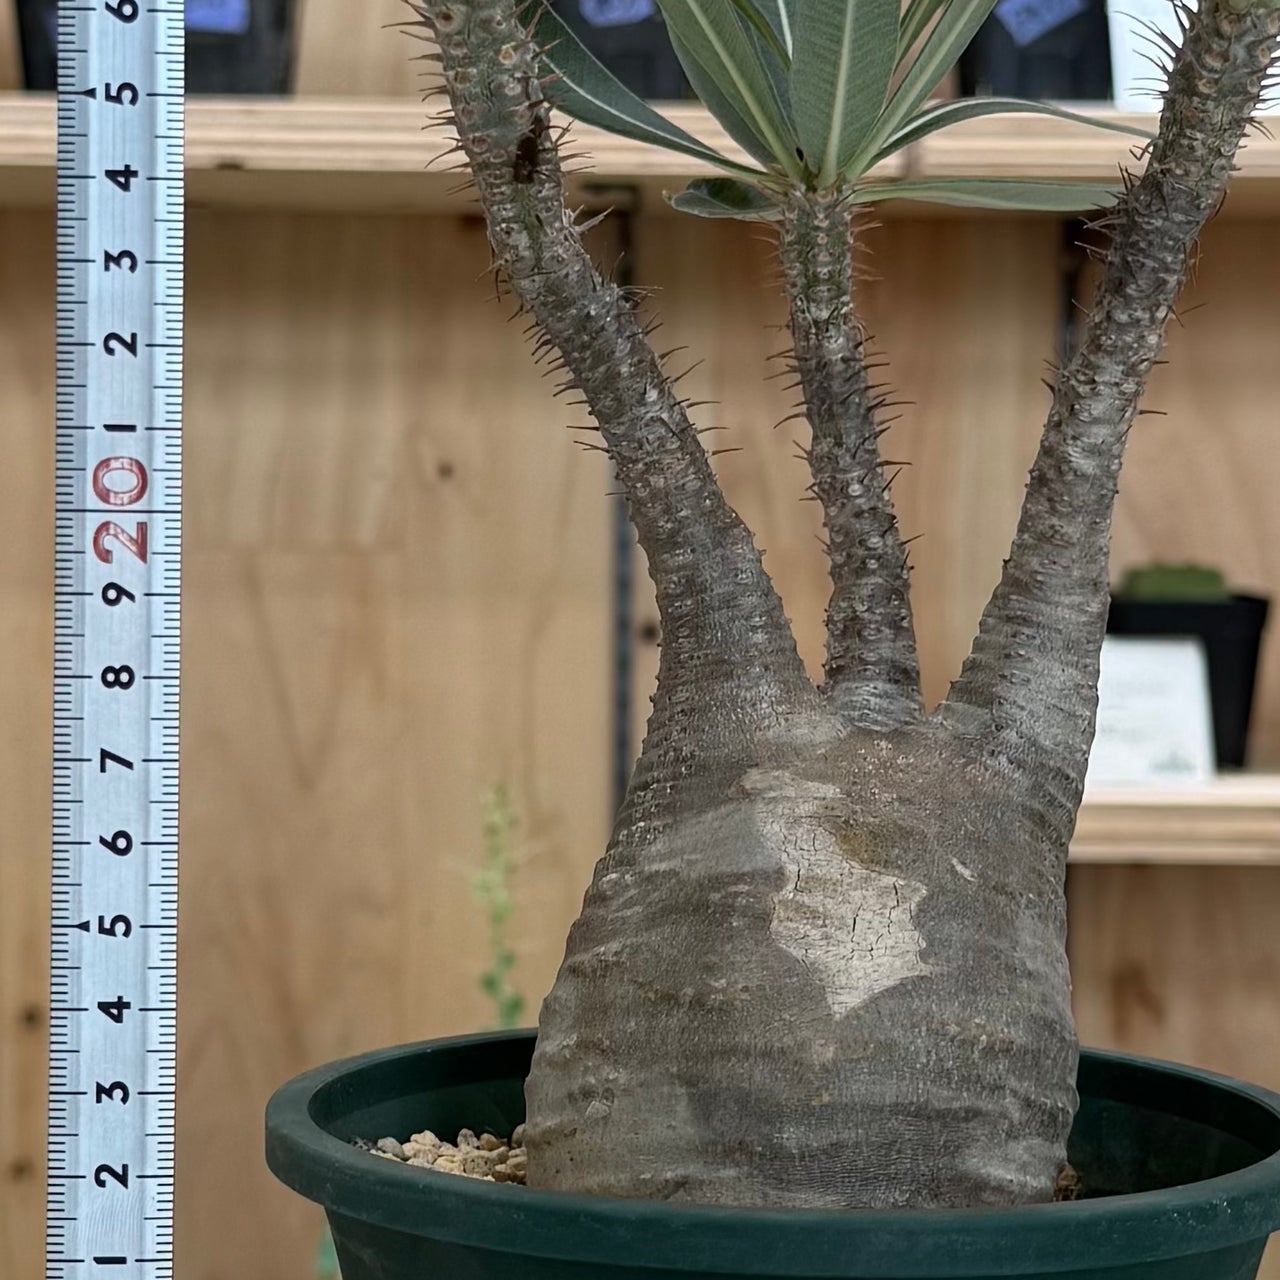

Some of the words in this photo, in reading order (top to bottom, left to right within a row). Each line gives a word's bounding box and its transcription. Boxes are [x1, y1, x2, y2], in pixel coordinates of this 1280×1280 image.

[104, 81, 139, 107] 5
[104, 163, 139, 193] 4
[103, 249, 138, 274] 3
[102, 331, 138, 358] 2
[102, 423, 137, 433] 1
[92, 456, 149, 564] 20
[101, 581, 136, 607] 9
[100, 664, 136, 691] 8
[99, 747, 134, 774] 7
[98, 829, 133, 857] 6
[97, 914, 132, 939] 5
[97, 995, 132, 1024] 4
[95, 1080, 130, 1106] 3
[93, 1163, 129, 1190] 2
[92, 1256, 128, 1265] 1
